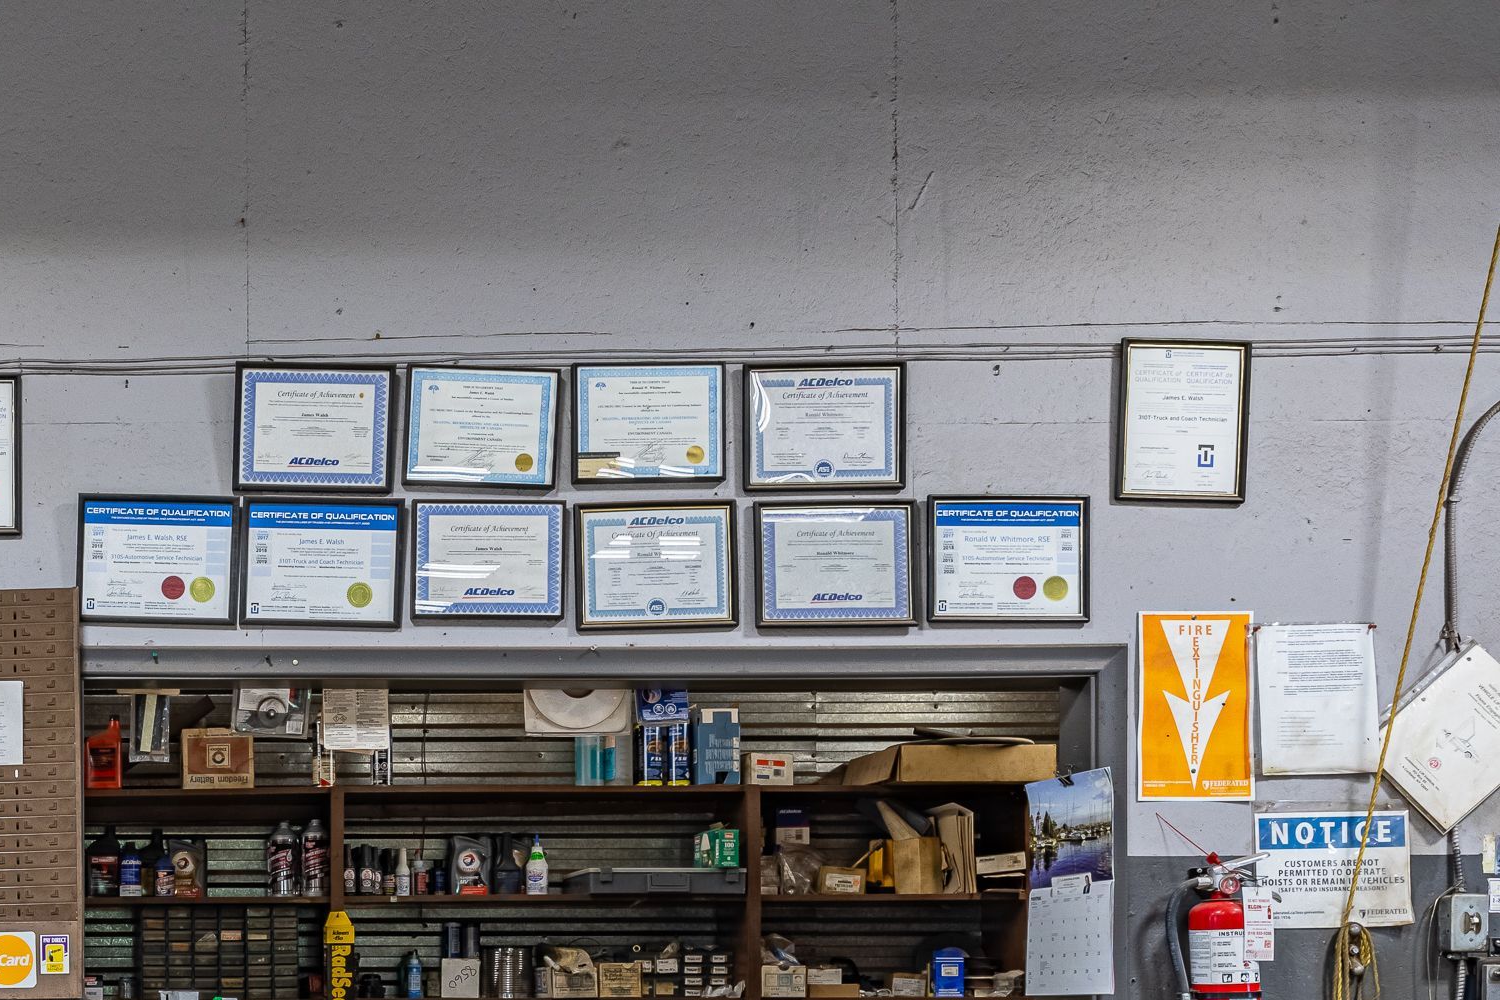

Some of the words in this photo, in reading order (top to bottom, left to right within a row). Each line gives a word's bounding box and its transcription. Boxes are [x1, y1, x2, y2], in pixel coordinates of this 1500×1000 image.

[799, 378, 853, 387] ACDelco
[318, 391, 356, 399] Achievement
[782, 392, 816, 400] Certificate
[827, 391, 868, 399] Achievement
[289, 457, 339, 466] ACDelco
[87, 507, 144, 515] CERTIFICATE
[161, 509, 230, 517] QUALIFICATION
[326, 513, 394, 521] QUALIFICATION
[630, 516, 685, 526] ACDelco
[155, 534, 175, 542] Walsh,
[796, 530, 828, 538] Certificate
[812, 593, 863, 601] ACDelco
[1179, 625, 1213, 636] FIRE
[1191, 636, 1201, 765] EXTINGUISHER
[1271, 821, 1392, 845] NOTICE
[1256, 878, 1292, 886] HOISTS
